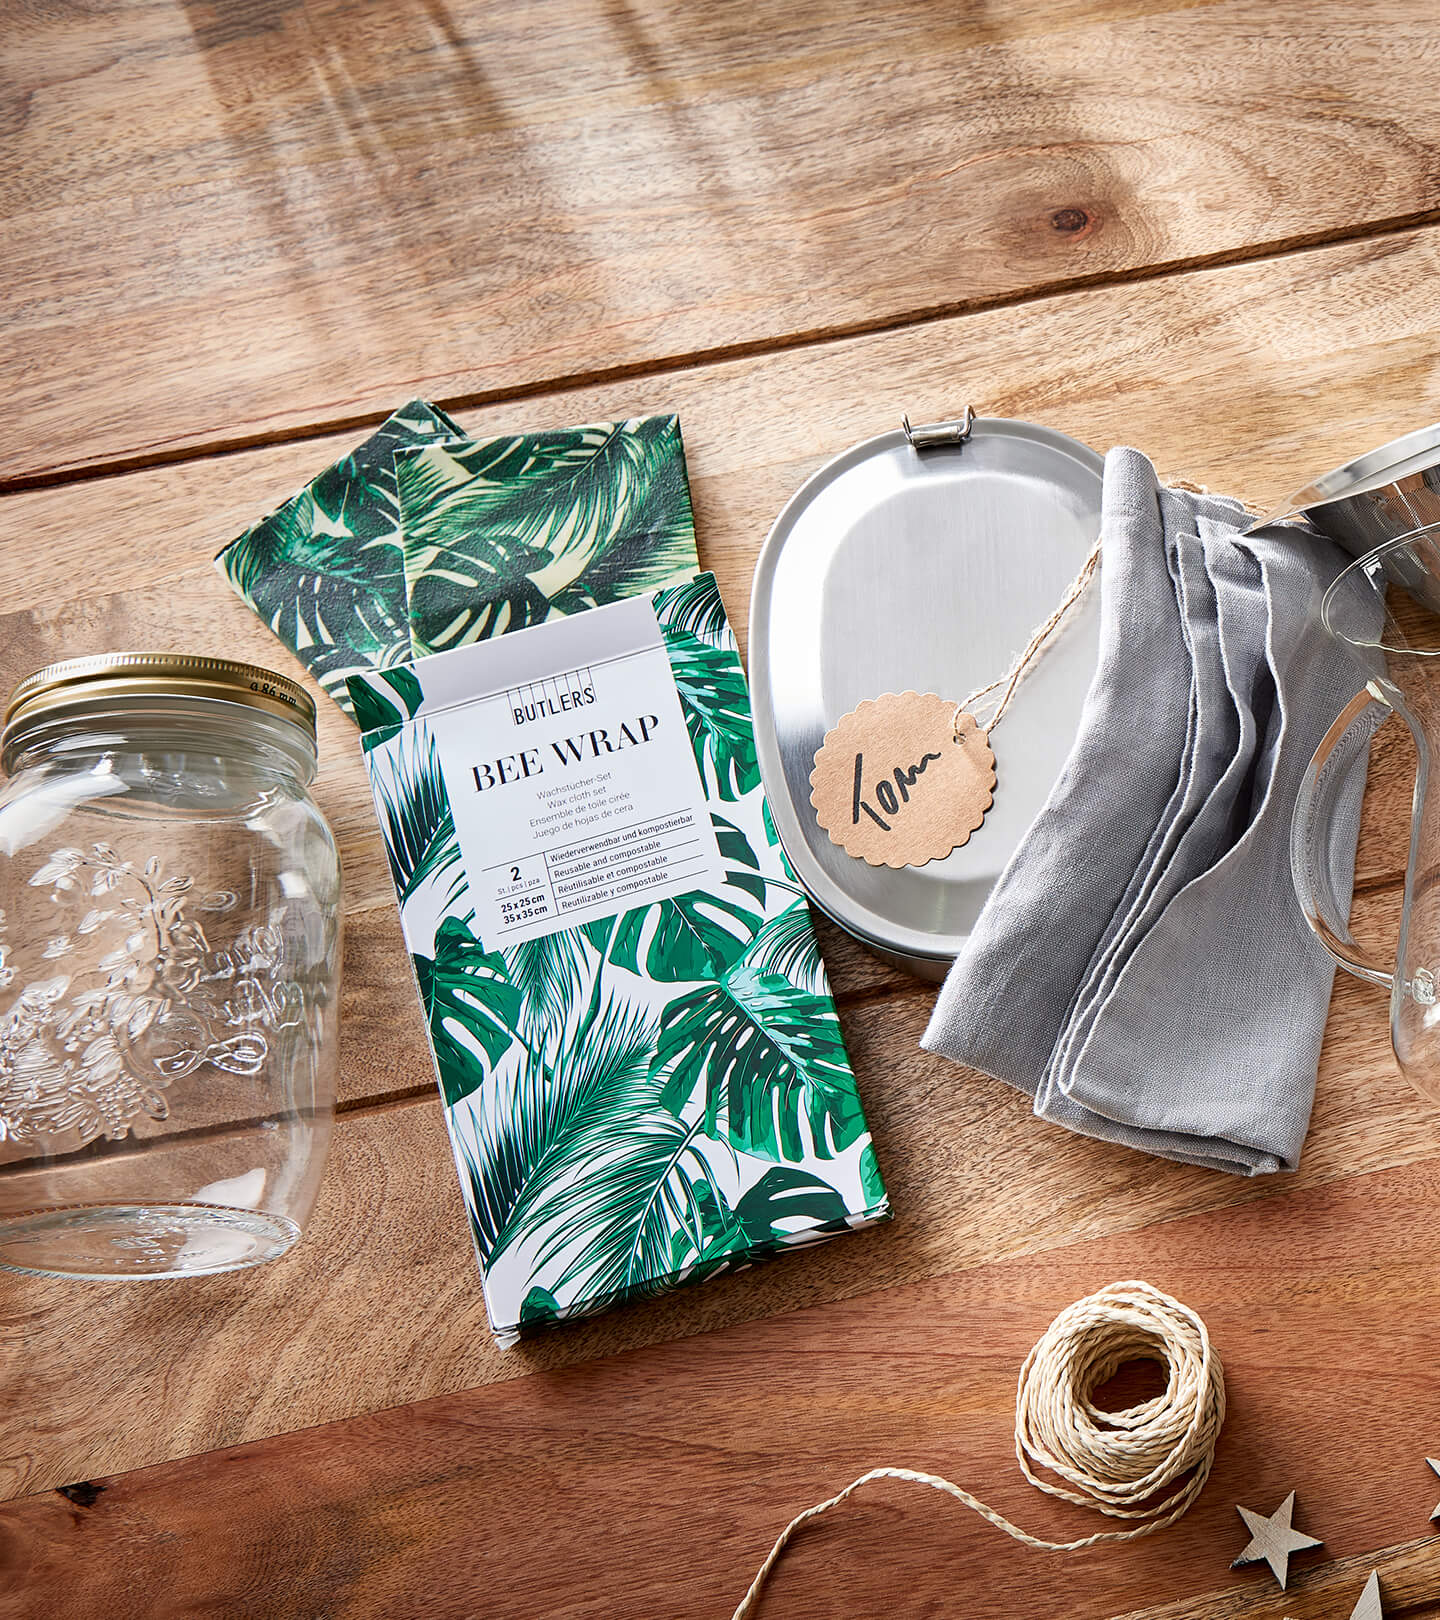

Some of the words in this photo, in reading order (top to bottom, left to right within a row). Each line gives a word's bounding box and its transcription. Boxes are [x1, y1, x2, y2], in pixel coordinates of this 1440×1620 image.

[261, 682, 277, 697] 86
[279, 691, 297, 706] mm
[513, 687, 596, 726] BUTLERS
[471, 748, 544, 793] BEE
[550, 714, 659, 766] WRAP
[529, 808, 574, 828] Ensemble
[575, 804, 587, 814] de
[587, 797, 608, 812] toile
[608, 791, 630, 805] cirée
[546, 797, 567, 810] Wax
[568, 789, 592, 804] cloth
[593, 785, 607, 797] set
[852, 751, 942, 831] Tom
[532, 825, 562, 840] Juego
[562, 820, 573, 830] de
[574, 812, 600, 827] hojas
[601, 808, 613, 819] de
[614, 802, 634, 815] cera
[550, 835, 621, 863] Wiederverwendbar
[622, 831, 637, 842] und
[637, 813, 694, 836] kompostierbar
[510, 866, 522, 881] 2
[553, 860, 591, 879] Reusable
[592, 855, 608, 867] and
[609, 840, 662, 862] compostable
[557, 872, 605, 894] Réutilisable
[606, 870, 614, 879] et
[616, 854, 668, 877] compostable
[500, 902, 513, 913] 25
[519, 897, 531, 908] 25
[531, 894, 545, 904] cm
[561, 888, 609, 909] Reutilizable
[609, 887, 615, 897] y
[616, 871, 668, 894] compostable
[503, 913, 516, 925] 35
[516, 913, 521, 921] x
[521, 908, 534, 919] 35
[534, 905, 548, 915] cm
